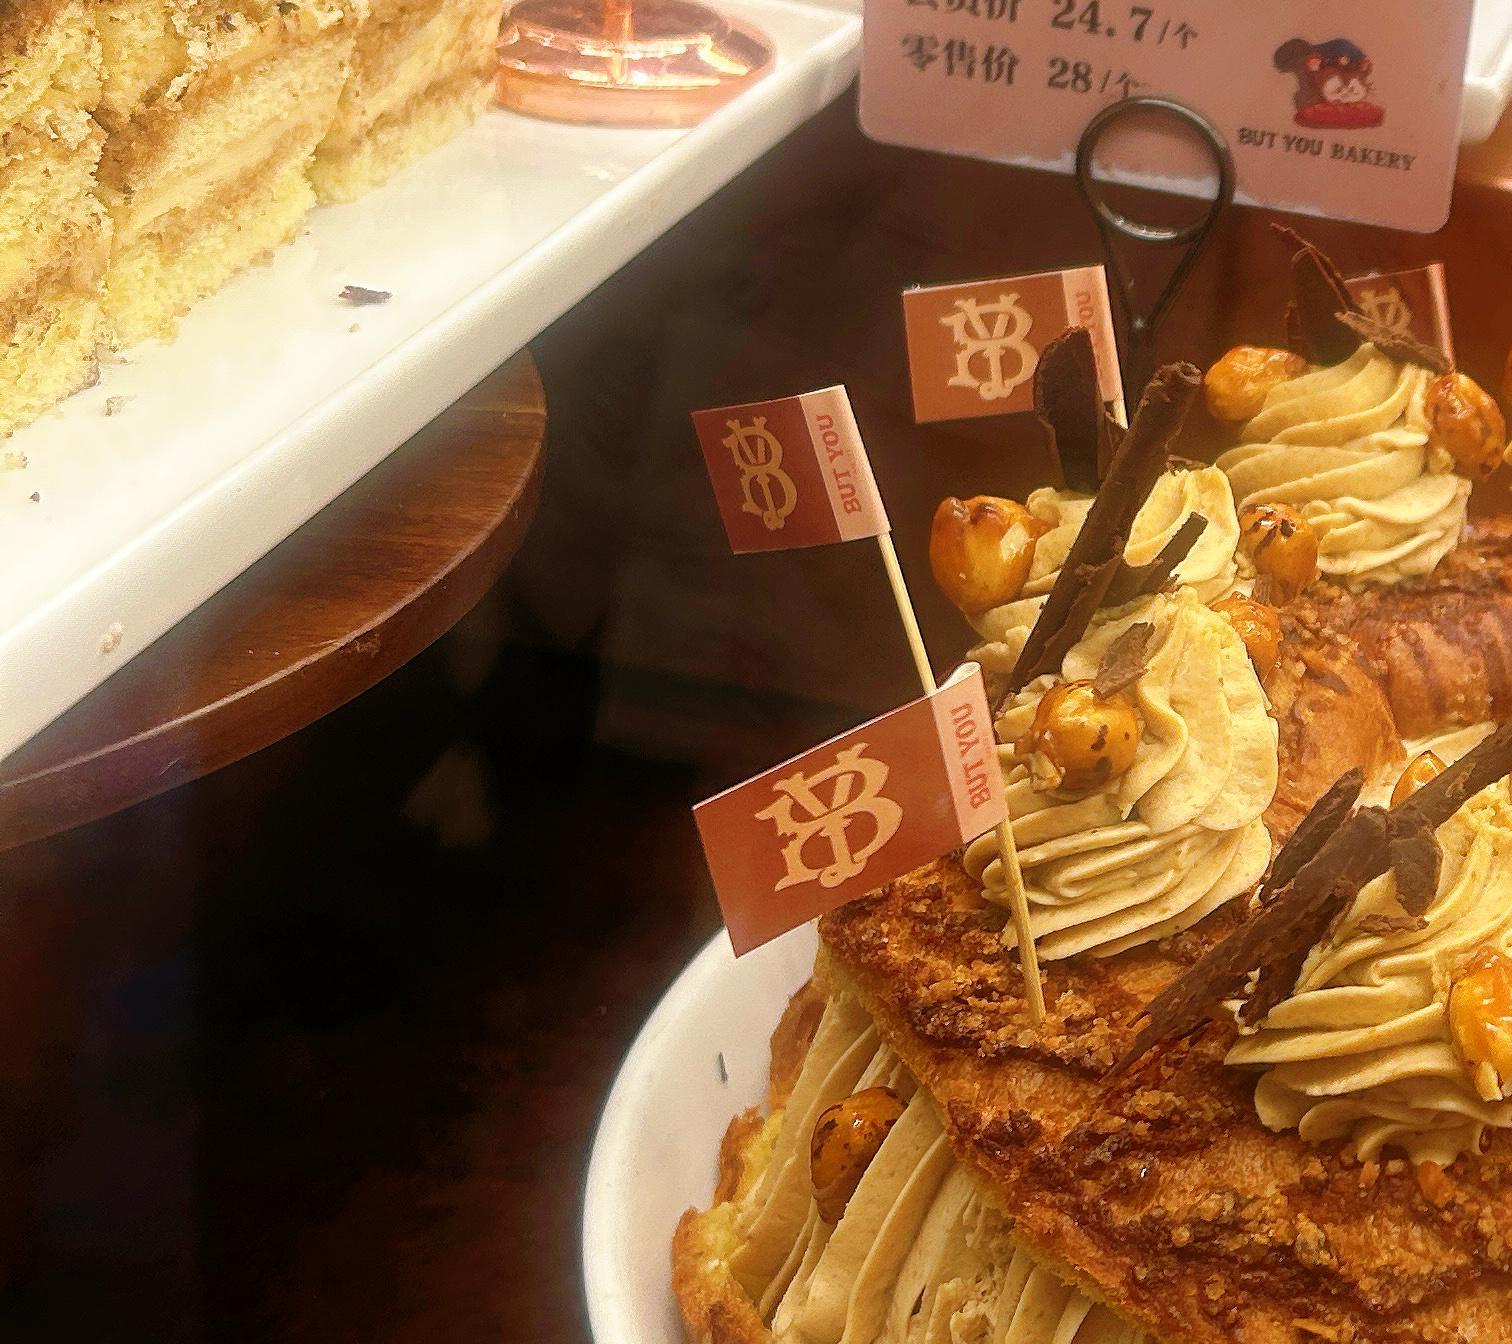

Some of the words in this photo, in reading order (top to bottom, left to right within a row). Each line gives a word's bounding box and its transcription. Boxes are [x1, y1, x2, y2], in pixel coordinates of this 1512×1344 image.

[901, 35, 1018, 87] 零售价
[1237, 127, 1278, 149] BUT
[1283, 135, 1323, 156] YOU
[1329, 143, 1416, 171] BAKERY
[816, 414, 843, 464] YOU
[832, 468, 862, 515] BUT
[949, 703, 980, 757] YOU
[961, 759, 991, 809] BUT
